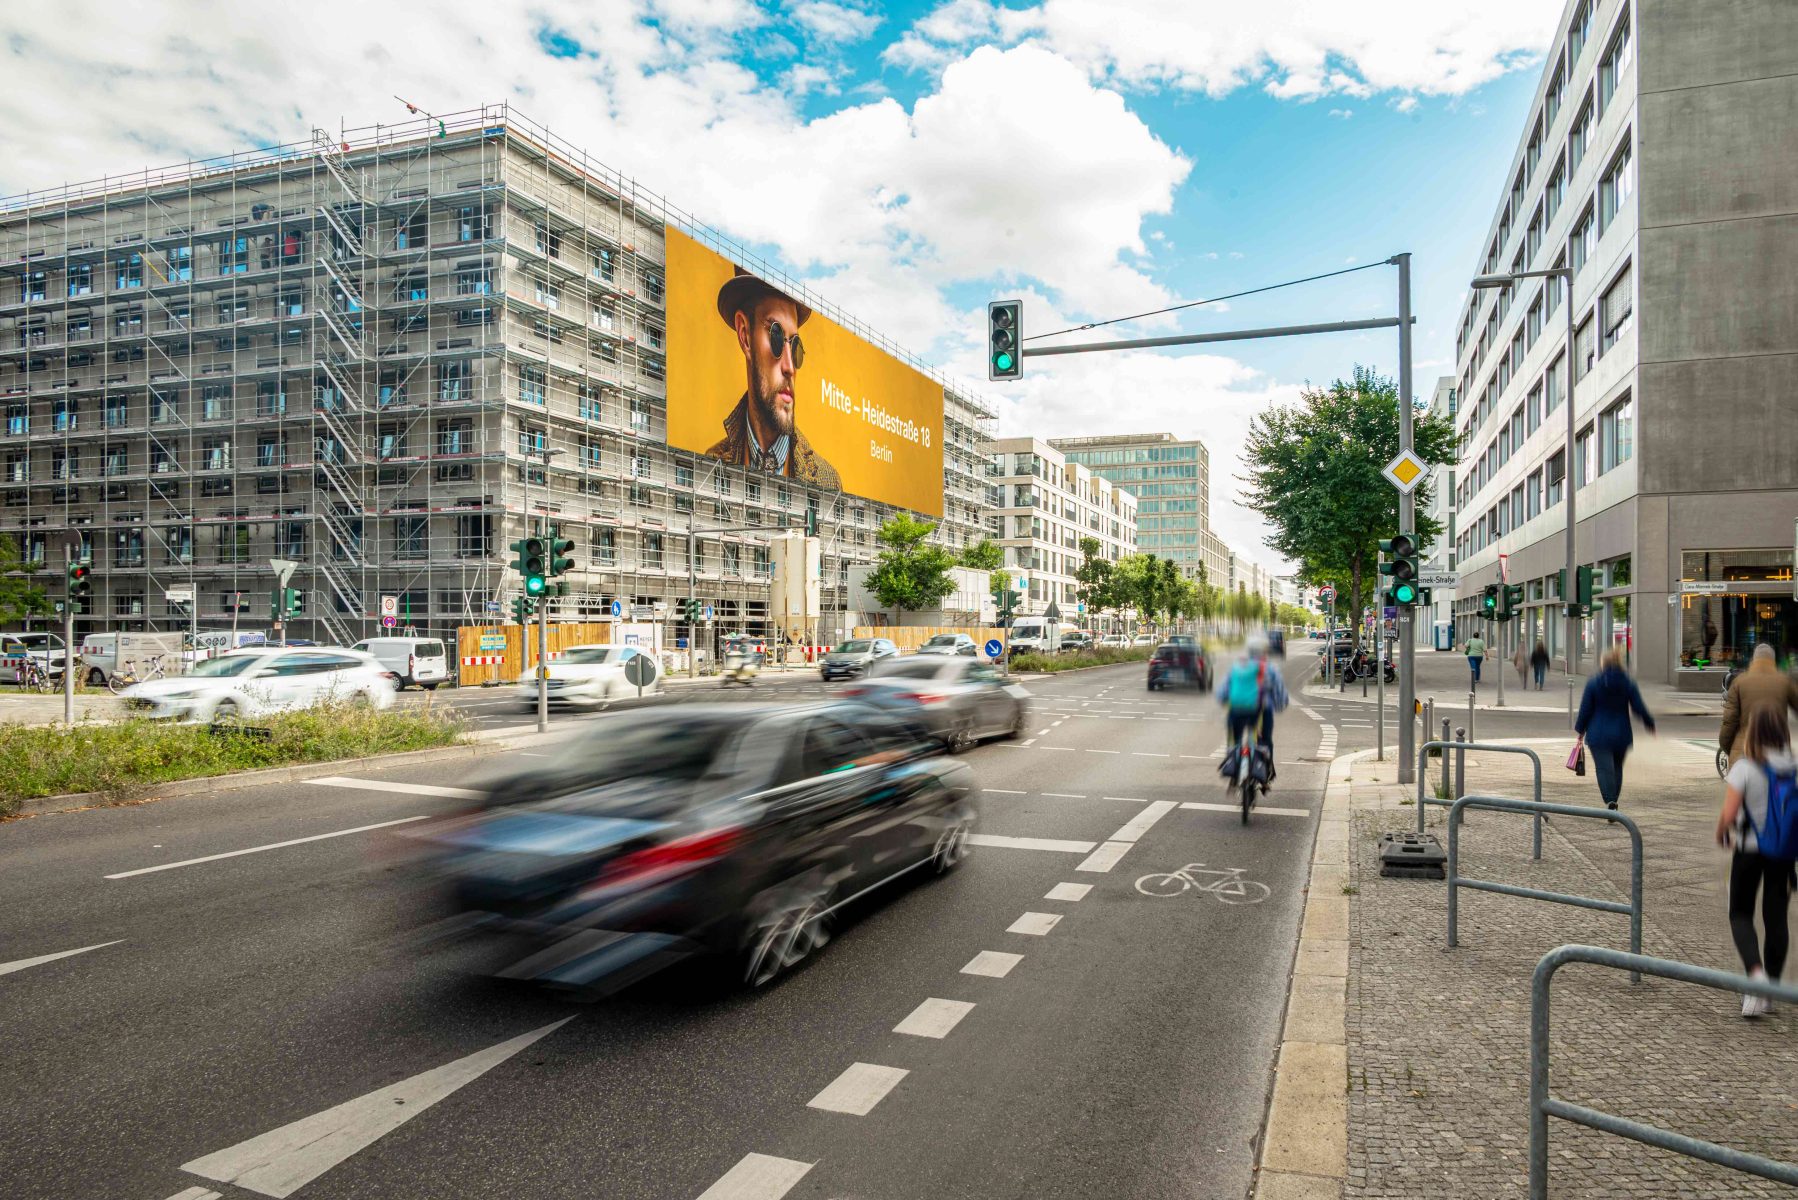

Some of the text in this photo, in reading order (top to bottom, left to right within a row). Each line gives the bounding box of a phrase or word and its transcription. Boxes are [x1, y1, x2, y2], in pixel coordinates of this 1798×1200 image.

[822, 379, 852, 414] Mitte
[862, 397, 919, 443] Heidestraße
[920, 426, 931, 448] 18
[871, 440, 893, 463] Berlin
